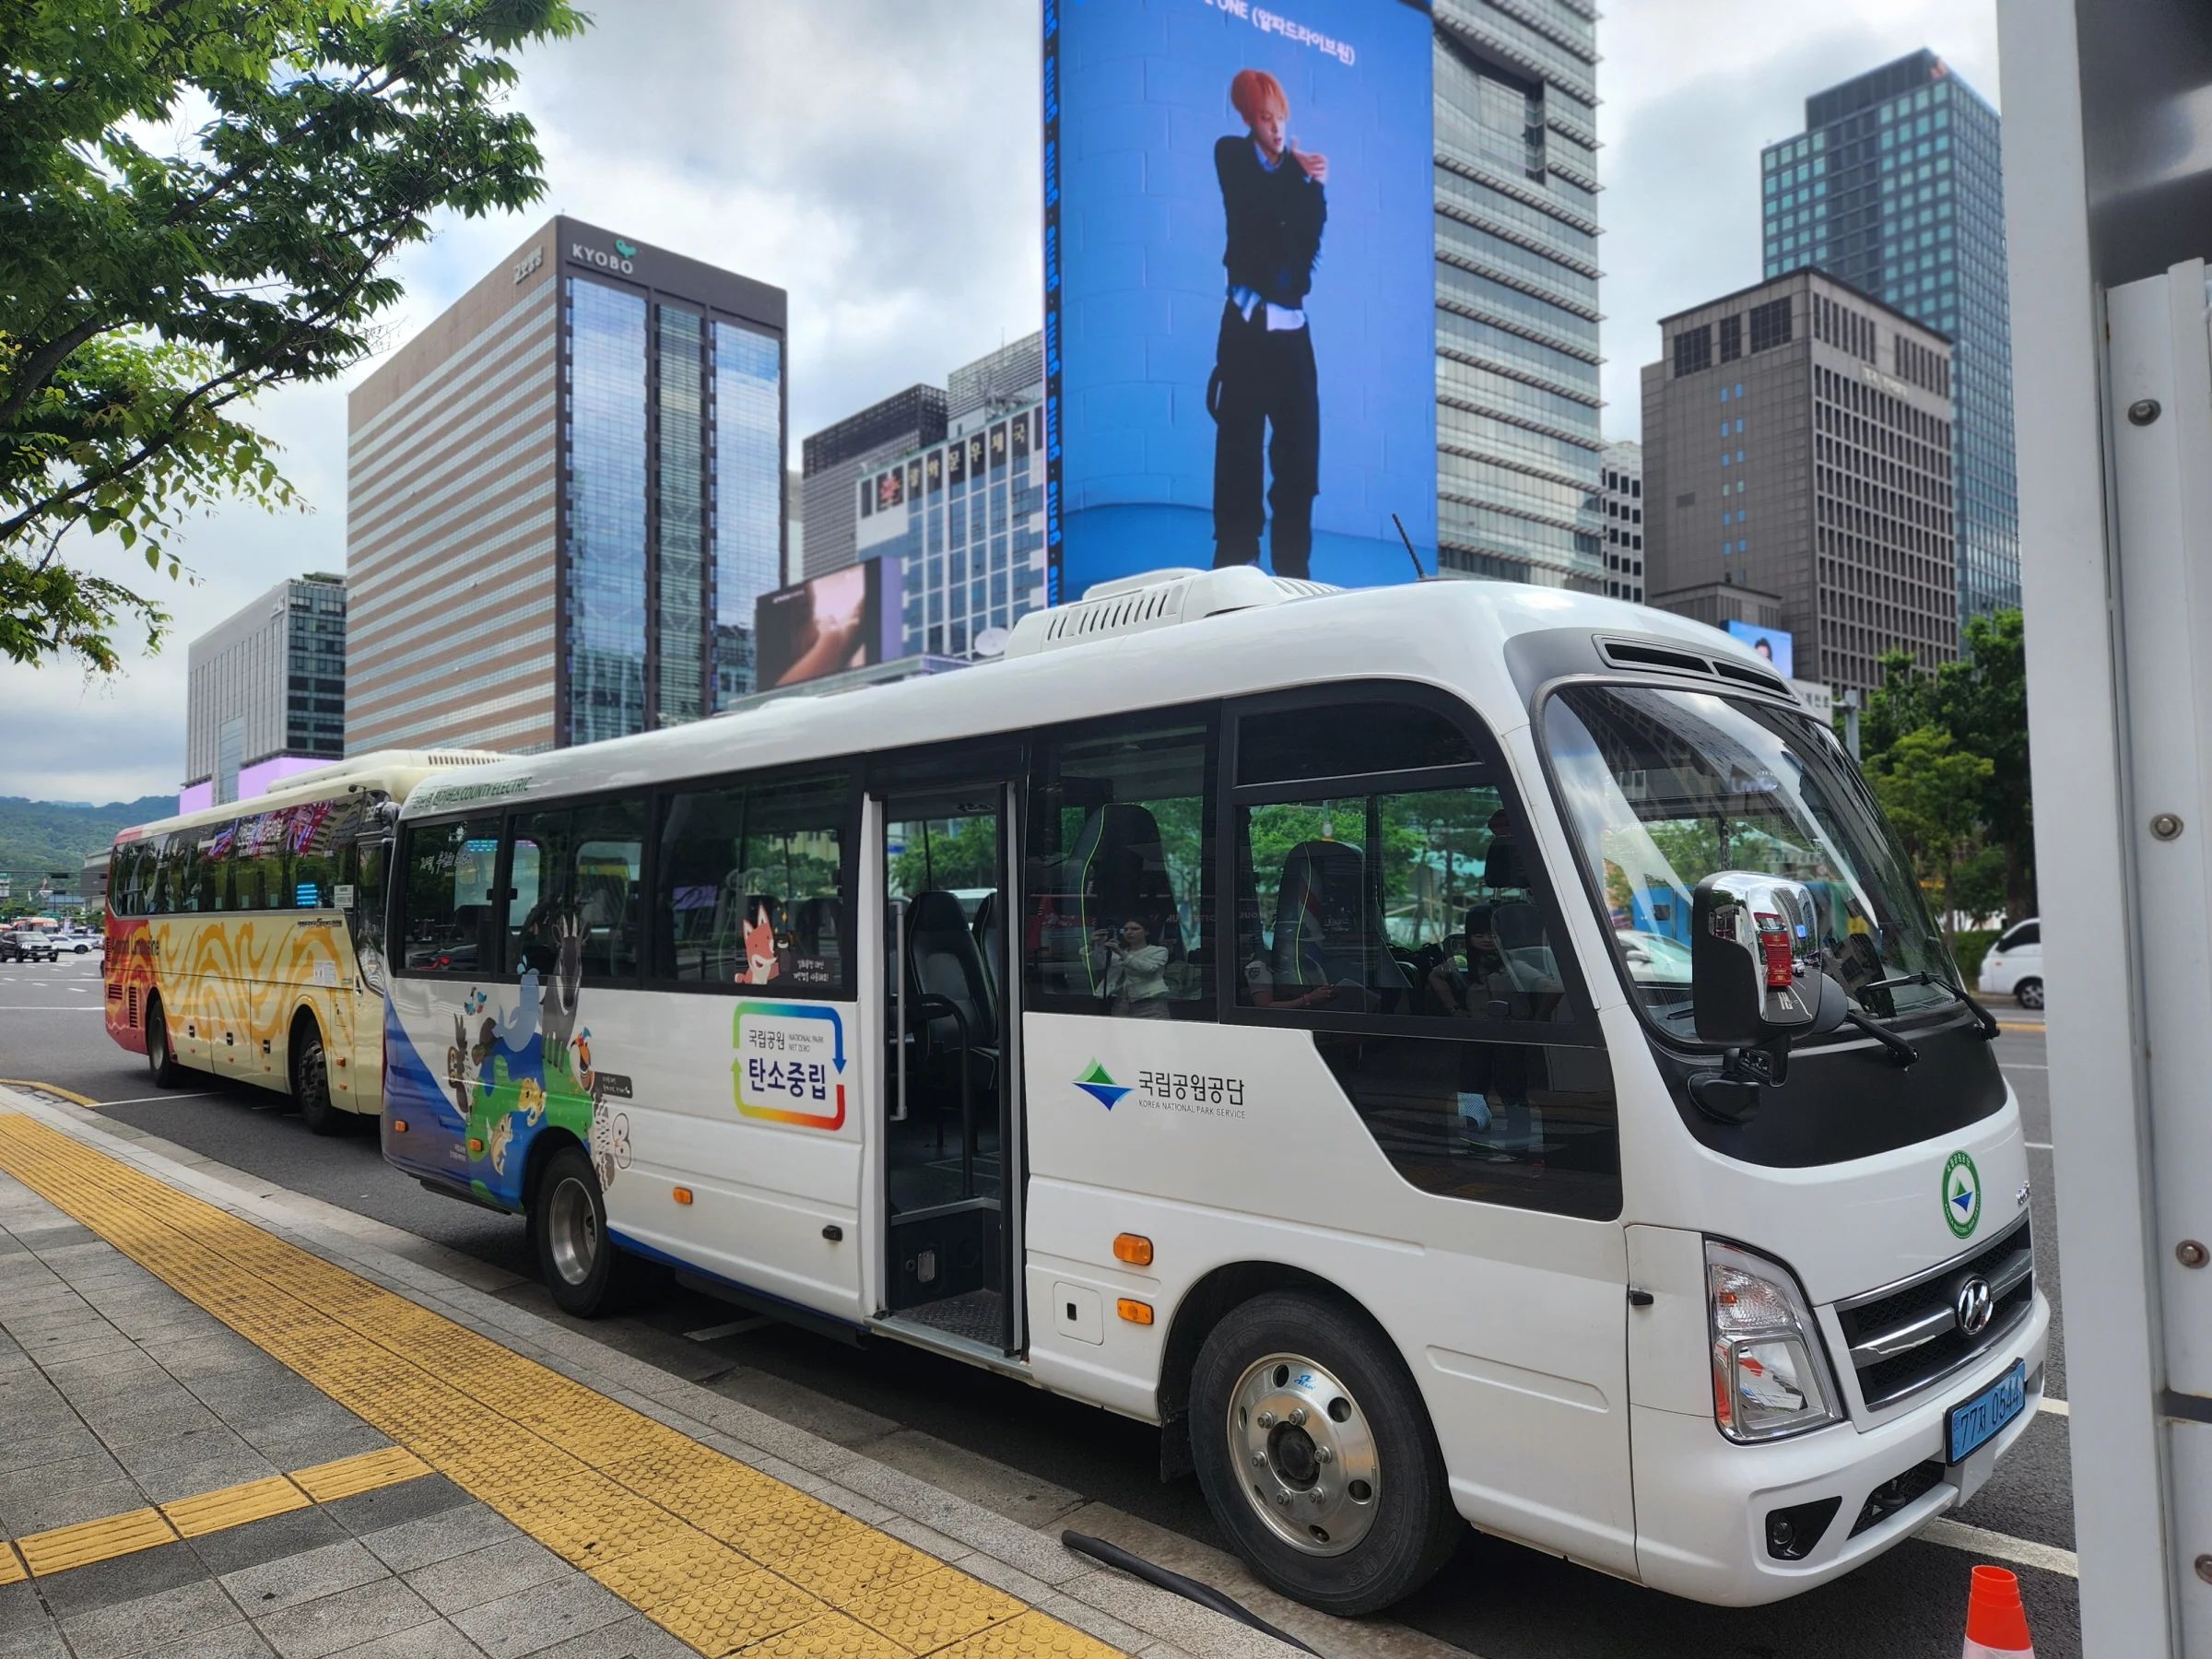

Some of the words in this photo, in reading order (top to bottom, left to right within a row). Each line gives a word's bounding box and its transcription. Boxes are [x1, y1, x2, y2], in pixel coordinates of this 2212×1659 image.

[1252, 6, 1355, 65] (알파드라이브원)
[572, 243, 633, 275] KYOBO
[460, 782, 491, 801] COUNTY
[490, 777, 533, 796] ELECTRIC
[748, 1030, 784, 1050] 국립공원
[789, 1033, 811, 1043] NATIONAL
[812, 1035, 824, 1044] PARK
[789, 1043, 797, 1052] NET
[798, 1044, 810, 1053] ZERO
[748, 1057, 826, 1100] 탄소중립
[1138, 1070, 1244, 1105] 국립공원공단
[1138, 1100, 1160, 1109] KOREA
[1161, 1101, 1195, 1113] NATIONAL
[1196, 1105, 1214, 1115] PARK
[1216, 1108, 1246, 1119] SERVICE
[1960, 1401, 1986, 1450] 77저
[1992, 1376, 2022, 1426] 0544
